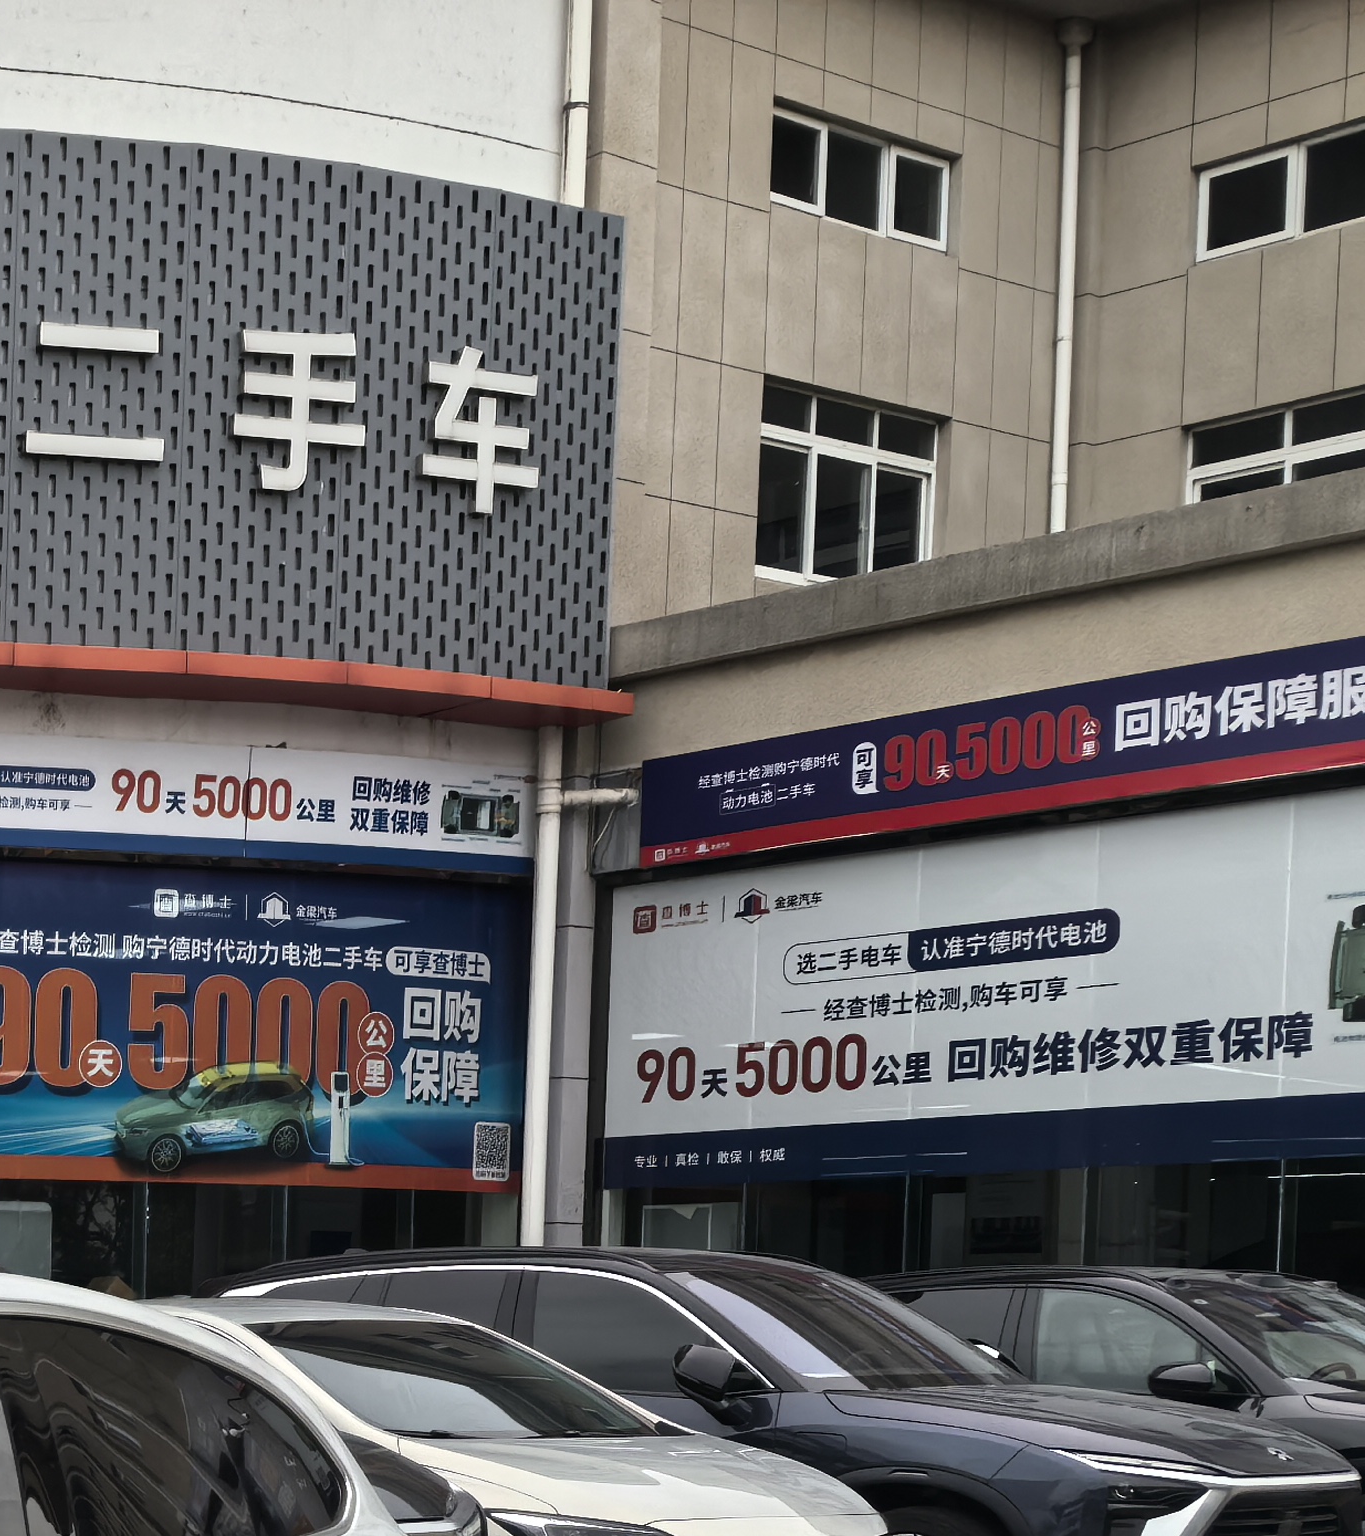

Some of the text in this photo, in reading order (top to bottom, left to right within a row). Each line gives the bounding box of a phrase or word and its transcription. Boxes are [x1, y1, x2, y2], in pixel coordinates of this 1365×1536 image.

[0, 770, 90, 787] 认准宁德时代电池
[699, 753, 840, 790] 经查博士检测购宁德时代
[351, 775, 432, 806] 回购维修
[721, 783, 816, 811] 动力电池二手车
[350, 806, 430, 837] 双重保障
[774, 891, 823, 910] 金梁汽车
[122, 934, 383, 973] 购宁德时代动力电池二手车
[392, 949, 489, 982] 可享查博士
[796, 921, 1107, 977] 选二手电车 认准宁德时代电池
[403, 987, 481, 1044] 回购
[823, 977, 1068, 1022] 经查博士检测,购车可享
[948, 1012, 1314, 1085] 回购维修双重保障
[401, 1048, 480, 1105] 保障
[675, 1152, 699, 1166] 真检
